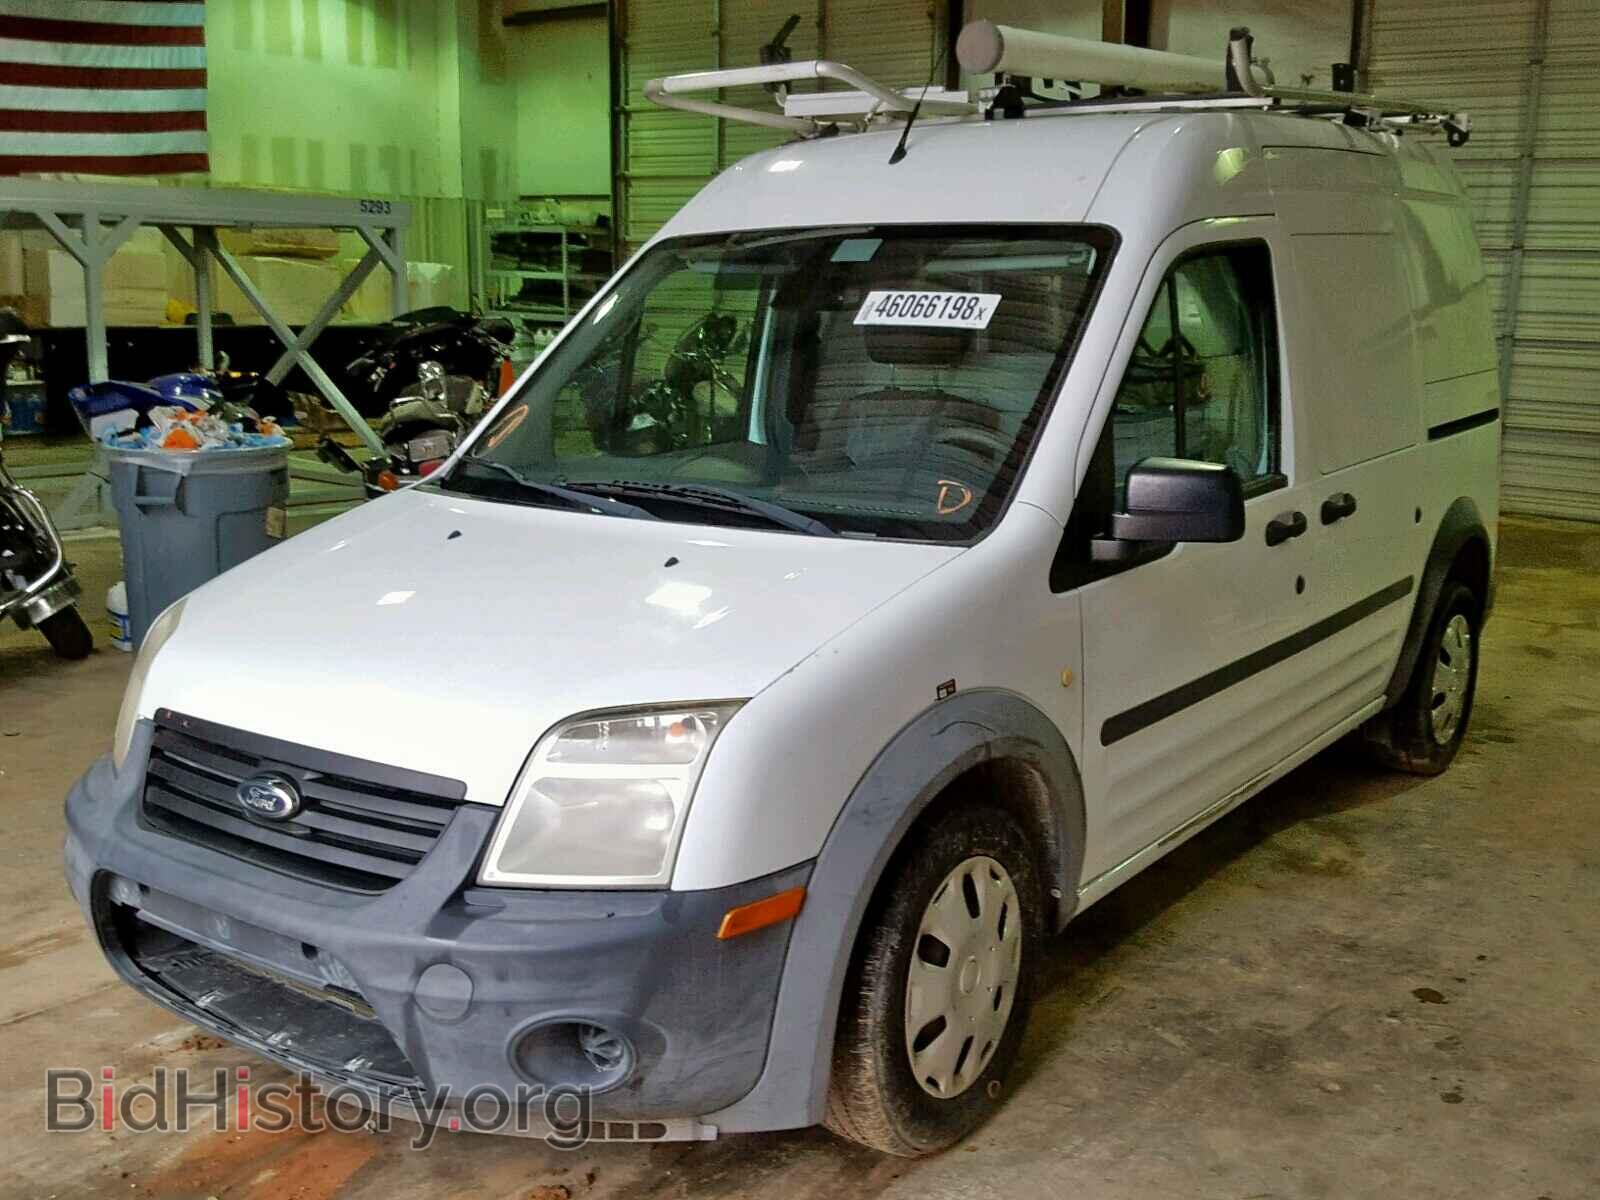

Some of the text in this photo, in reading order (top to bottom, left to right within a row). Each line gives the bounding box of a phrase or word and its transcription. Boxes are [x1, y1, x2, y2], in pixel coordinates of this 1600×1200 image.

[360, 199, 391, 215] 5293
[936, 479, 974, 515] D
[246, 786, 278, 812] Ford
